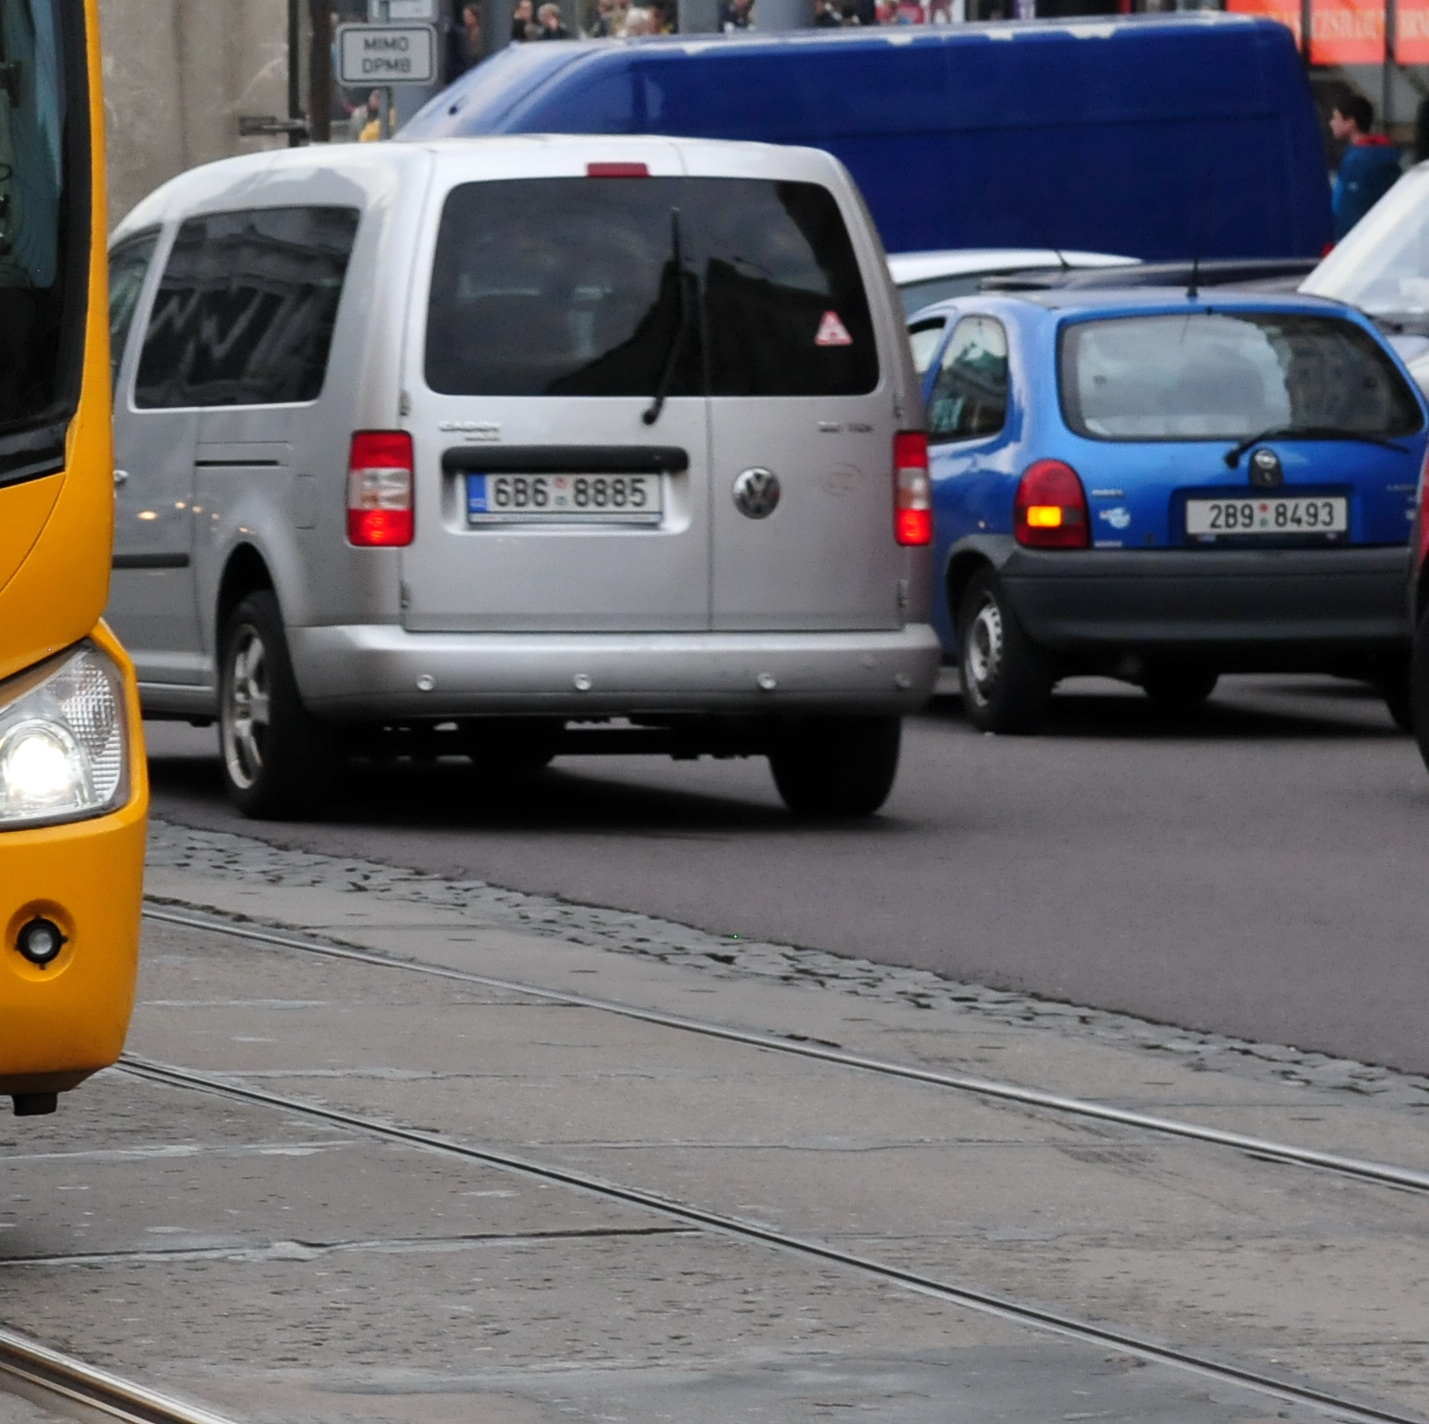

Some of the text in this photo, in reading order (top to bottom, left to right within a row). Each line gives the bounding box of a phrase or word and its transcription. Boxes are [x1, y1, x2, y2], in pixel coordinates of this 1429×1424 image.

[363, 36, 409, 52] MIMO
[362, 57, 411, 74] DPMB
[494, 478, 549, 507] 6B6
[573, 478, 647, 507] 8885
[1209, 501, 1335, 530] 2B9 8493
